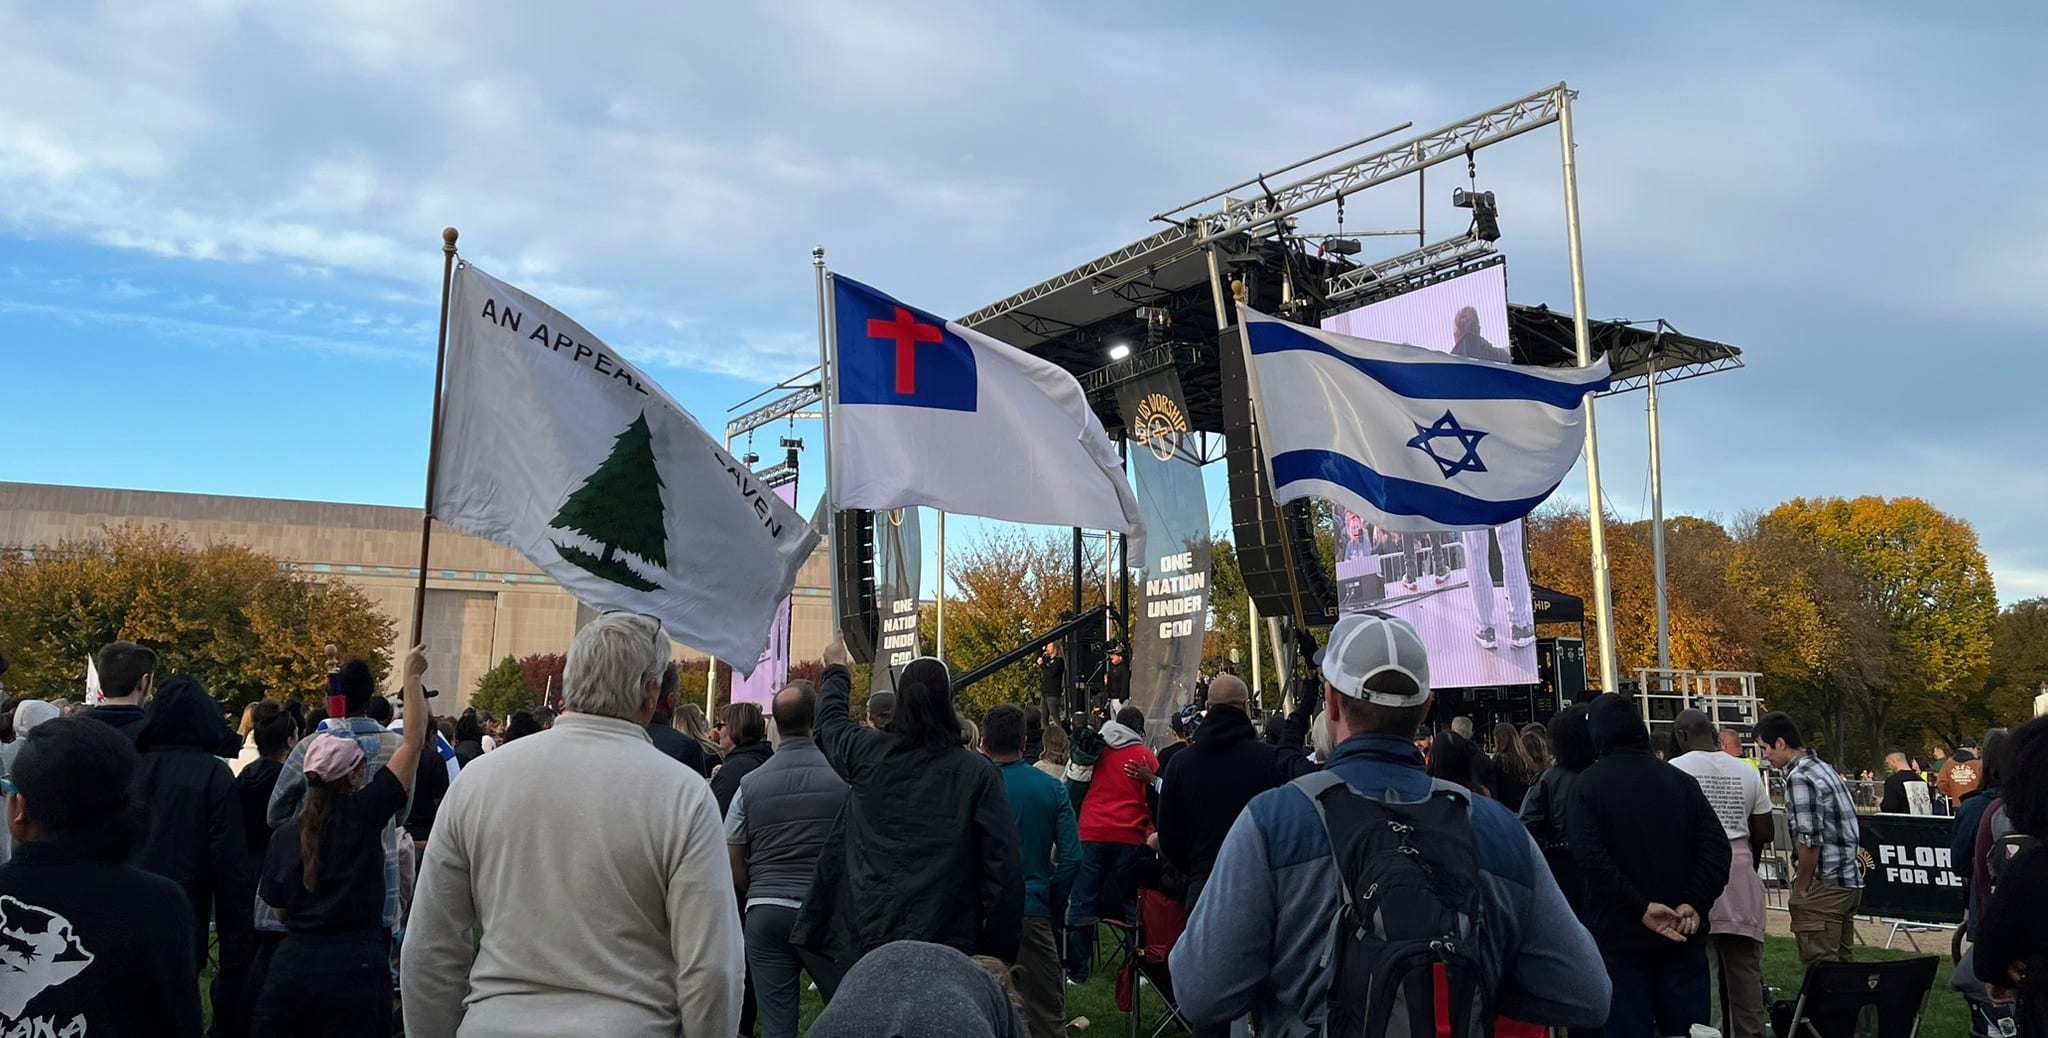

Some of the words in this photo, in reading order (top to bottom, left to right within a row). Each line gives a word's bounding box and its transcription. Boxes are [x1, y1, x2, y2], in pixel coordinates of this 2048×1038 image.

[481, 298, 522, 333] AN
[529, 323, 650, 396] APPEAL
[1137, 399, 1151, 420] US
[1147, 393, 1187, 433] WORSHIP
[1134, 415, 1148, 446] LET
[714, 452, 783, 538] AVEN
[1160, 552, 1193, 573] ONE
[1146, 572, 1205, 597] NATION
[893, 598, 914, 614] ONE
[1147, 595, 1202, 618] UNDER
[1534, 600, 1551, 611] HIP
[883, 615, 917, 633] NATIO
[1159, 619, 1193, 639] GOD
[883, 632, 915, 650] UNDE
[890, 651, 912, 666] GOD
[1879, 844, 1952, 868] FLOR
[1886, 867, 1929, 885] FOR
[1935, 870, 1963, 887] JE
